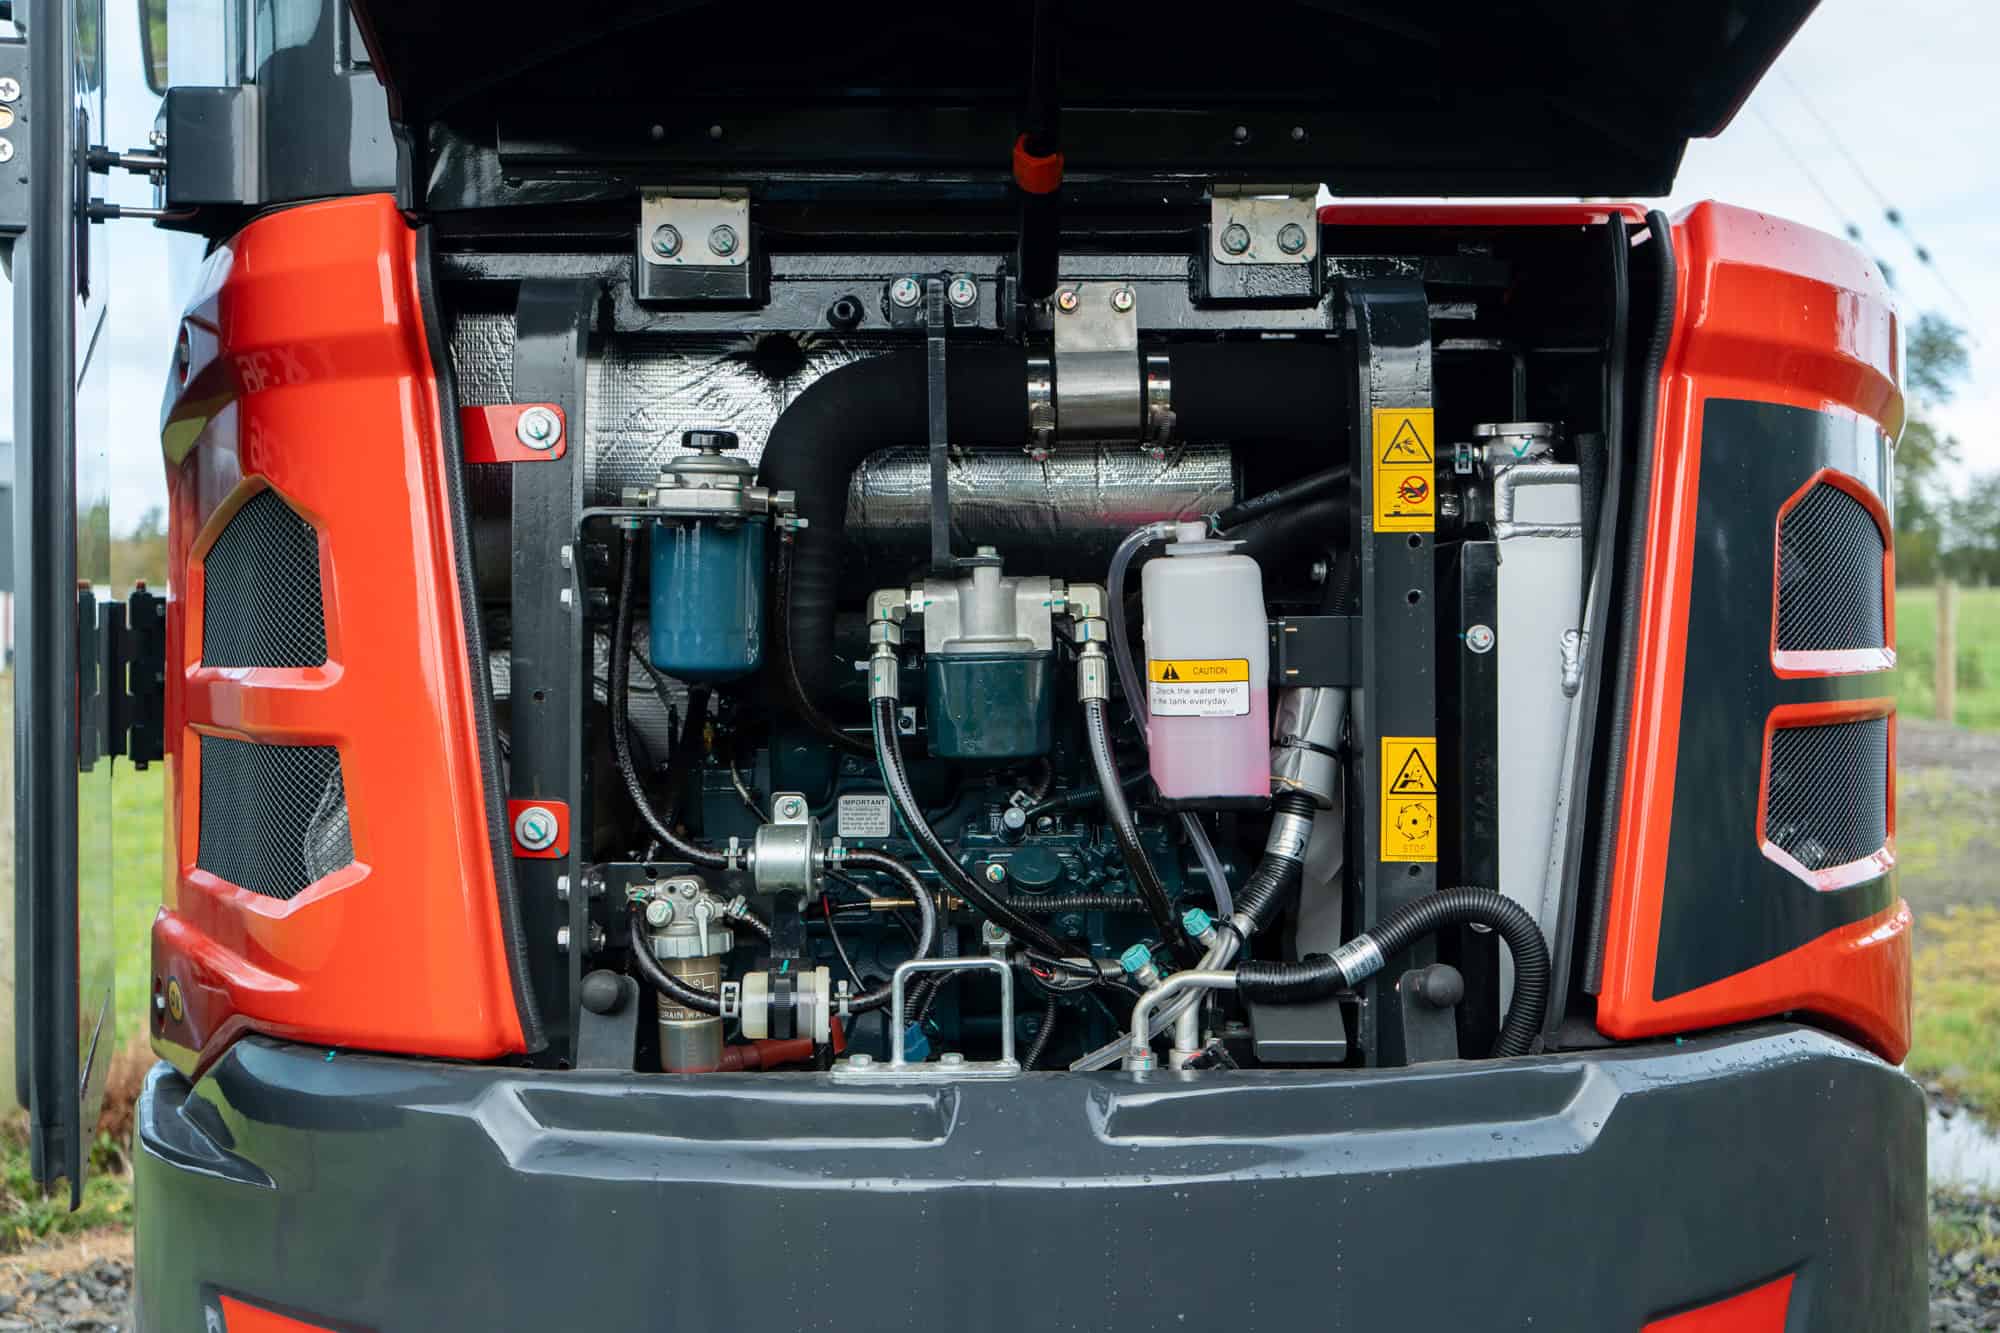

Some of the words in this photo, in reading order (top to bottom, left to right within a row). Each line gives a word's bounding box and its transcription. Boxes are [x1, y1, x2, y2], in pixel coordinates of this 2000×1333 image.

[1192, 666, 1228, 676] CAUTION
[1178, 687, 1190, 695] the
[1193, 687, 1216, 695] water
[1218, 686, 1239, 695] level
[1169, 697, 1187, 705] tank
[1402, 844, 1426, 853] STOP
